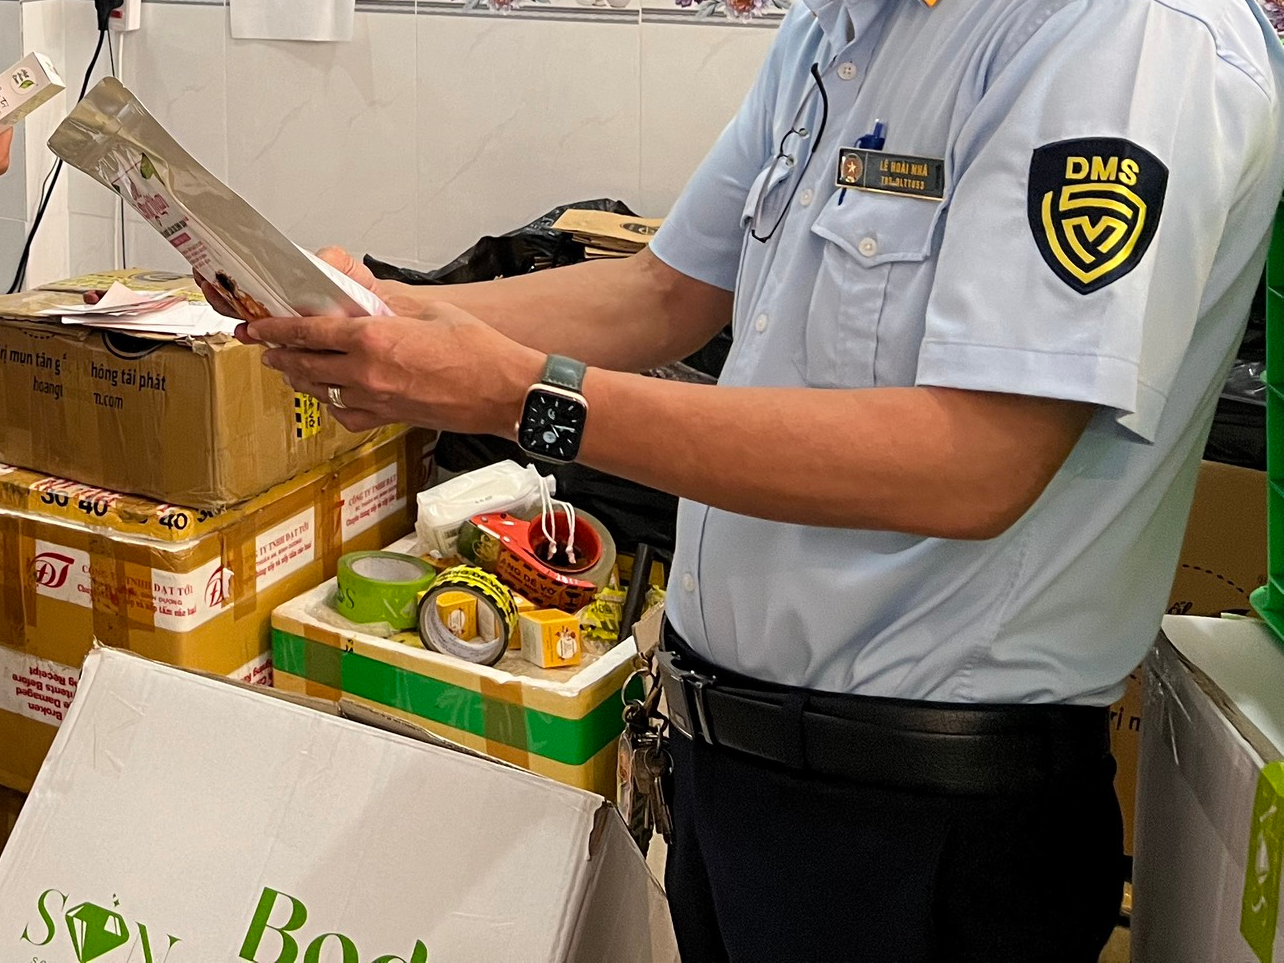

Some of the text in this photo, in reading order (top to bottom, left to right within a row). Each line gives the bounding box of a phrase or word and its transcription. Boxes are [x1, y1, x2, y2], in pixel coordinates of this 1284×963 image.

[1065, 156, 1140, 186] DMS
[91, 361, 119, 387] hông
[158, 512, 188, 530] 40
[12, 673, 43, 691] Before
[29, 666, 66, 686] Receipt
[15, 686, 61, 709] Damaged
[27, 702, 63, 721] Broken
